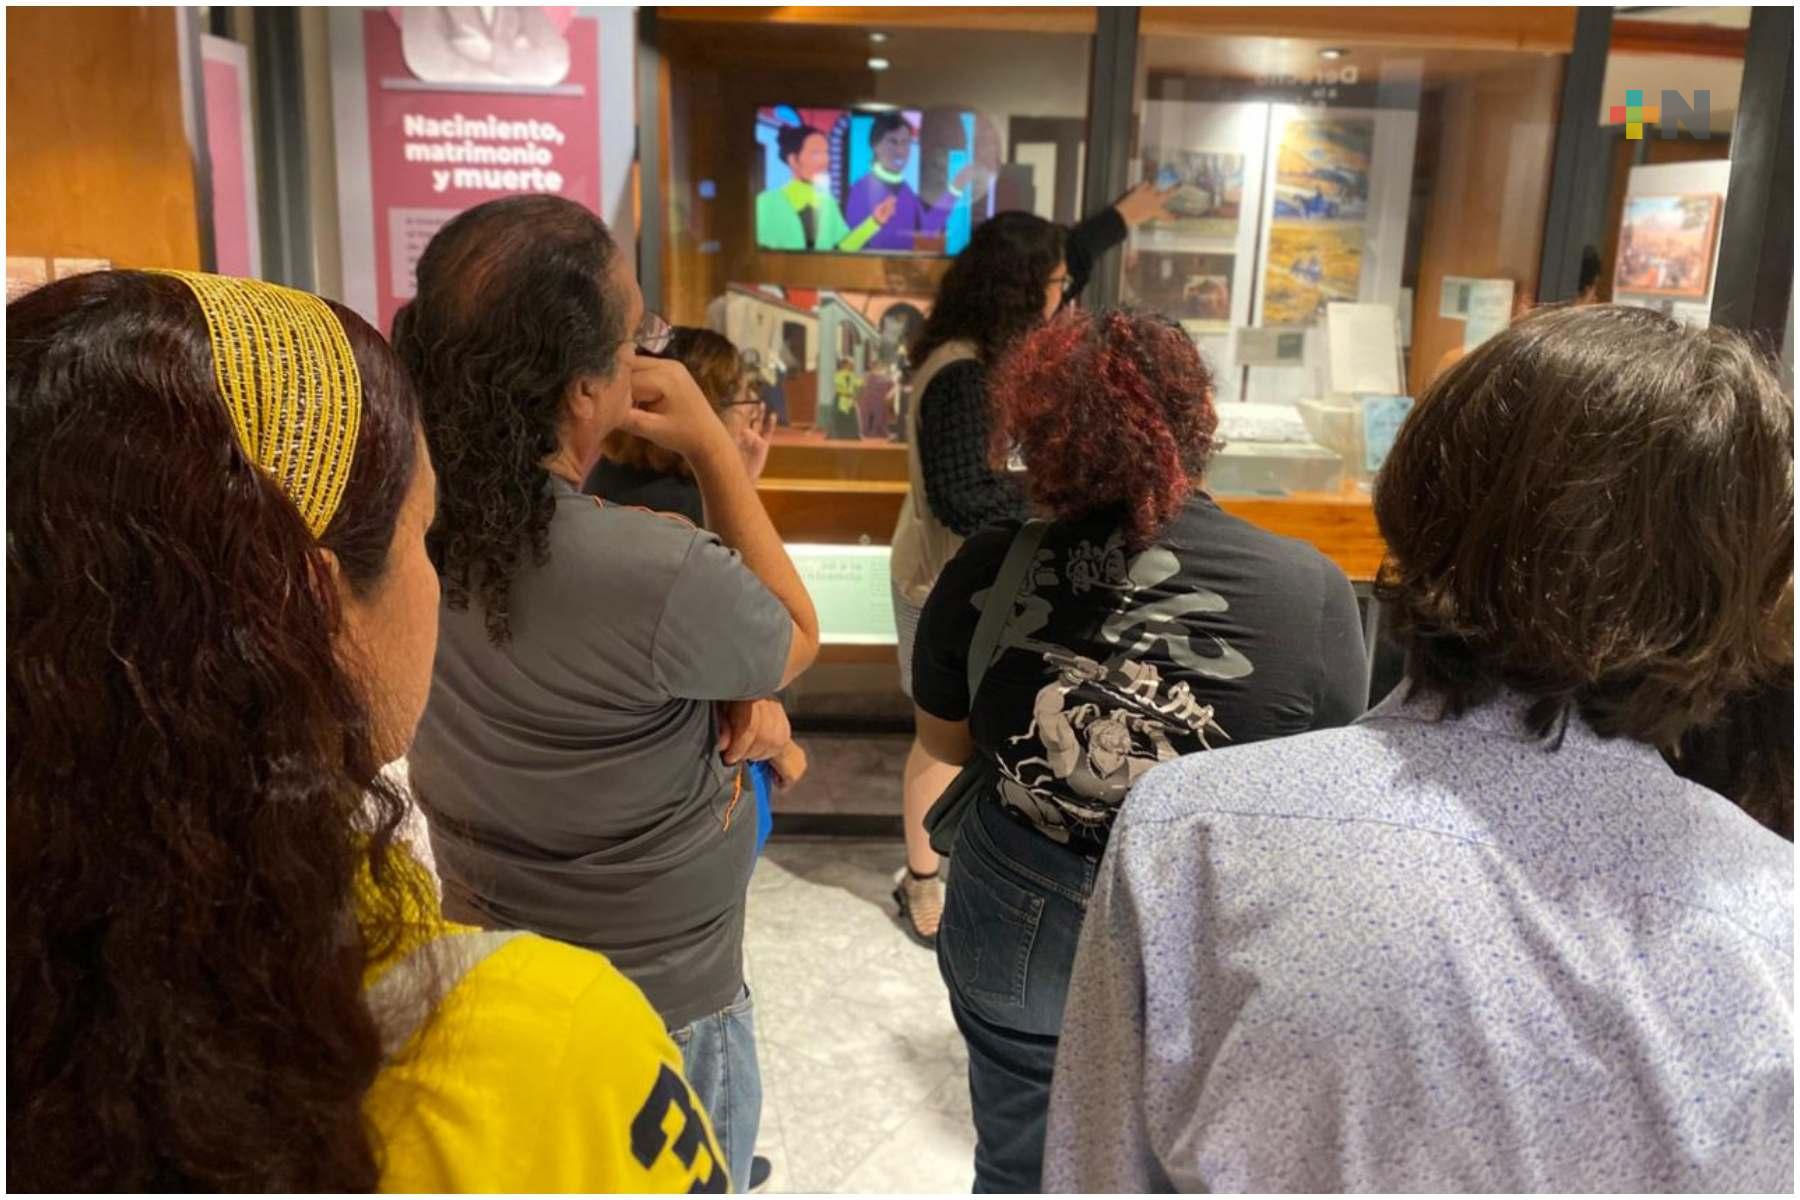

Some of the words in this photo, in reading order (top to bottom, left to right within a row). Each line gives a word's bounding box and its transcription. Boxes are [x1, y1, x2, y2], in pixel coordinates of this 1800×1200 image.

[404, 114, 565, 145] Nacimiento,
[404, 141, 553, 165] matrimonio
[432, 169, 451, 193] y
[453, 167, 563, 191] muerte
